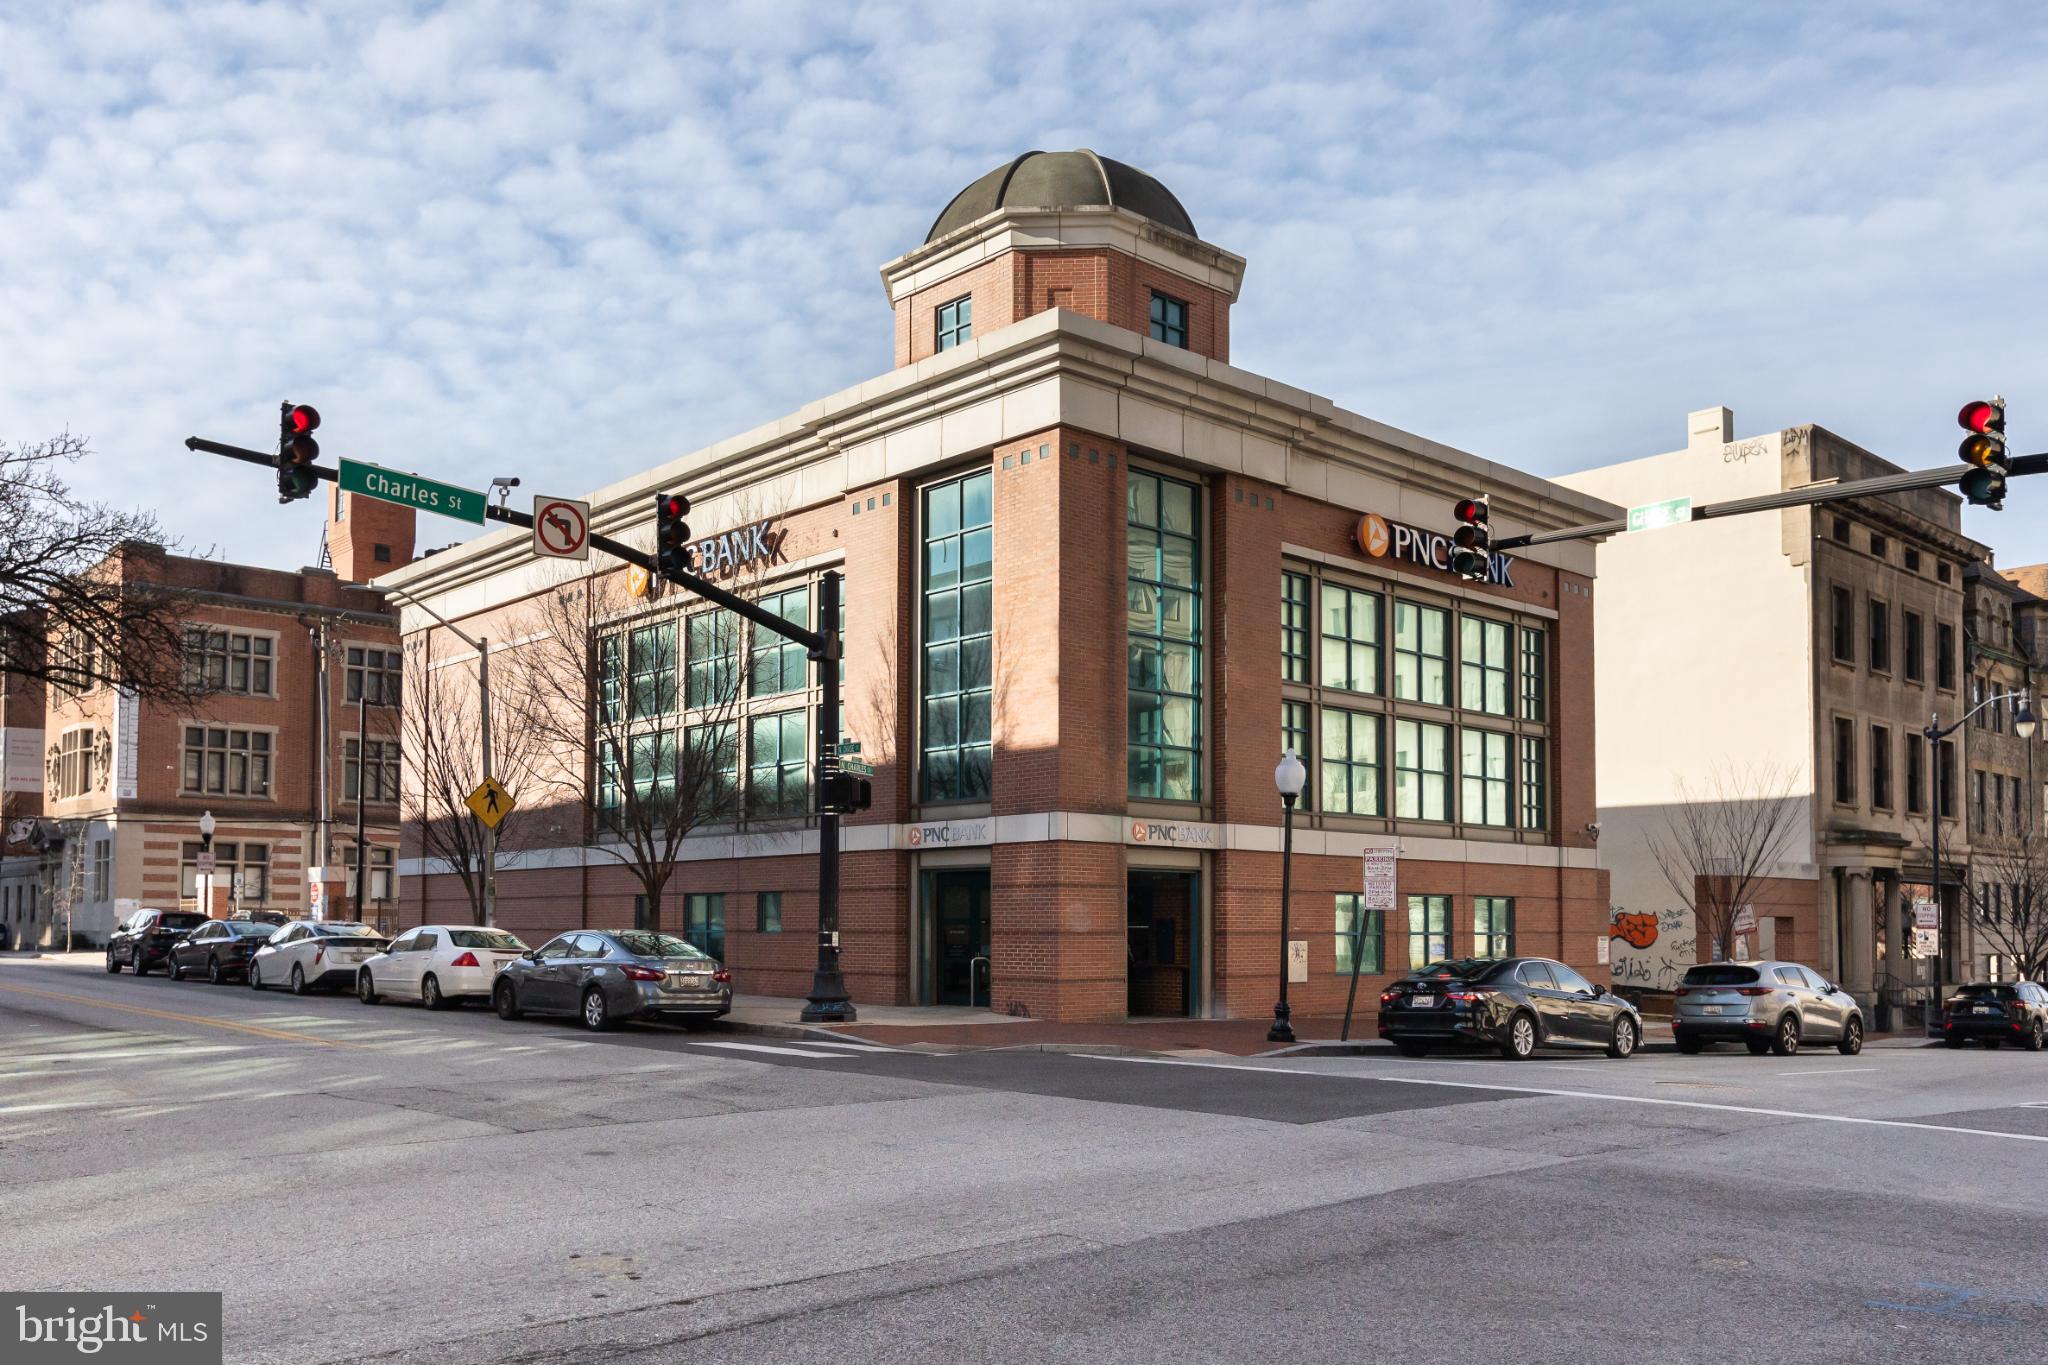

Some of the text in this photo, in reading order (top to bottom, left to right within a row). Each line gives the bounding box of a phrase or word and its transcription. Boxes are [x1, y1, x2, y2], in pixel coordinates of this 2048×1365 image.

[366, 473, 462, 510] Charles St
[700, 521, 769, 573] BANK
[1392, 524, 1448, 570] PNC
[923, 824, 986, 842] PNC BANK
[1148, 825, 1213, 843] PNC BANK
